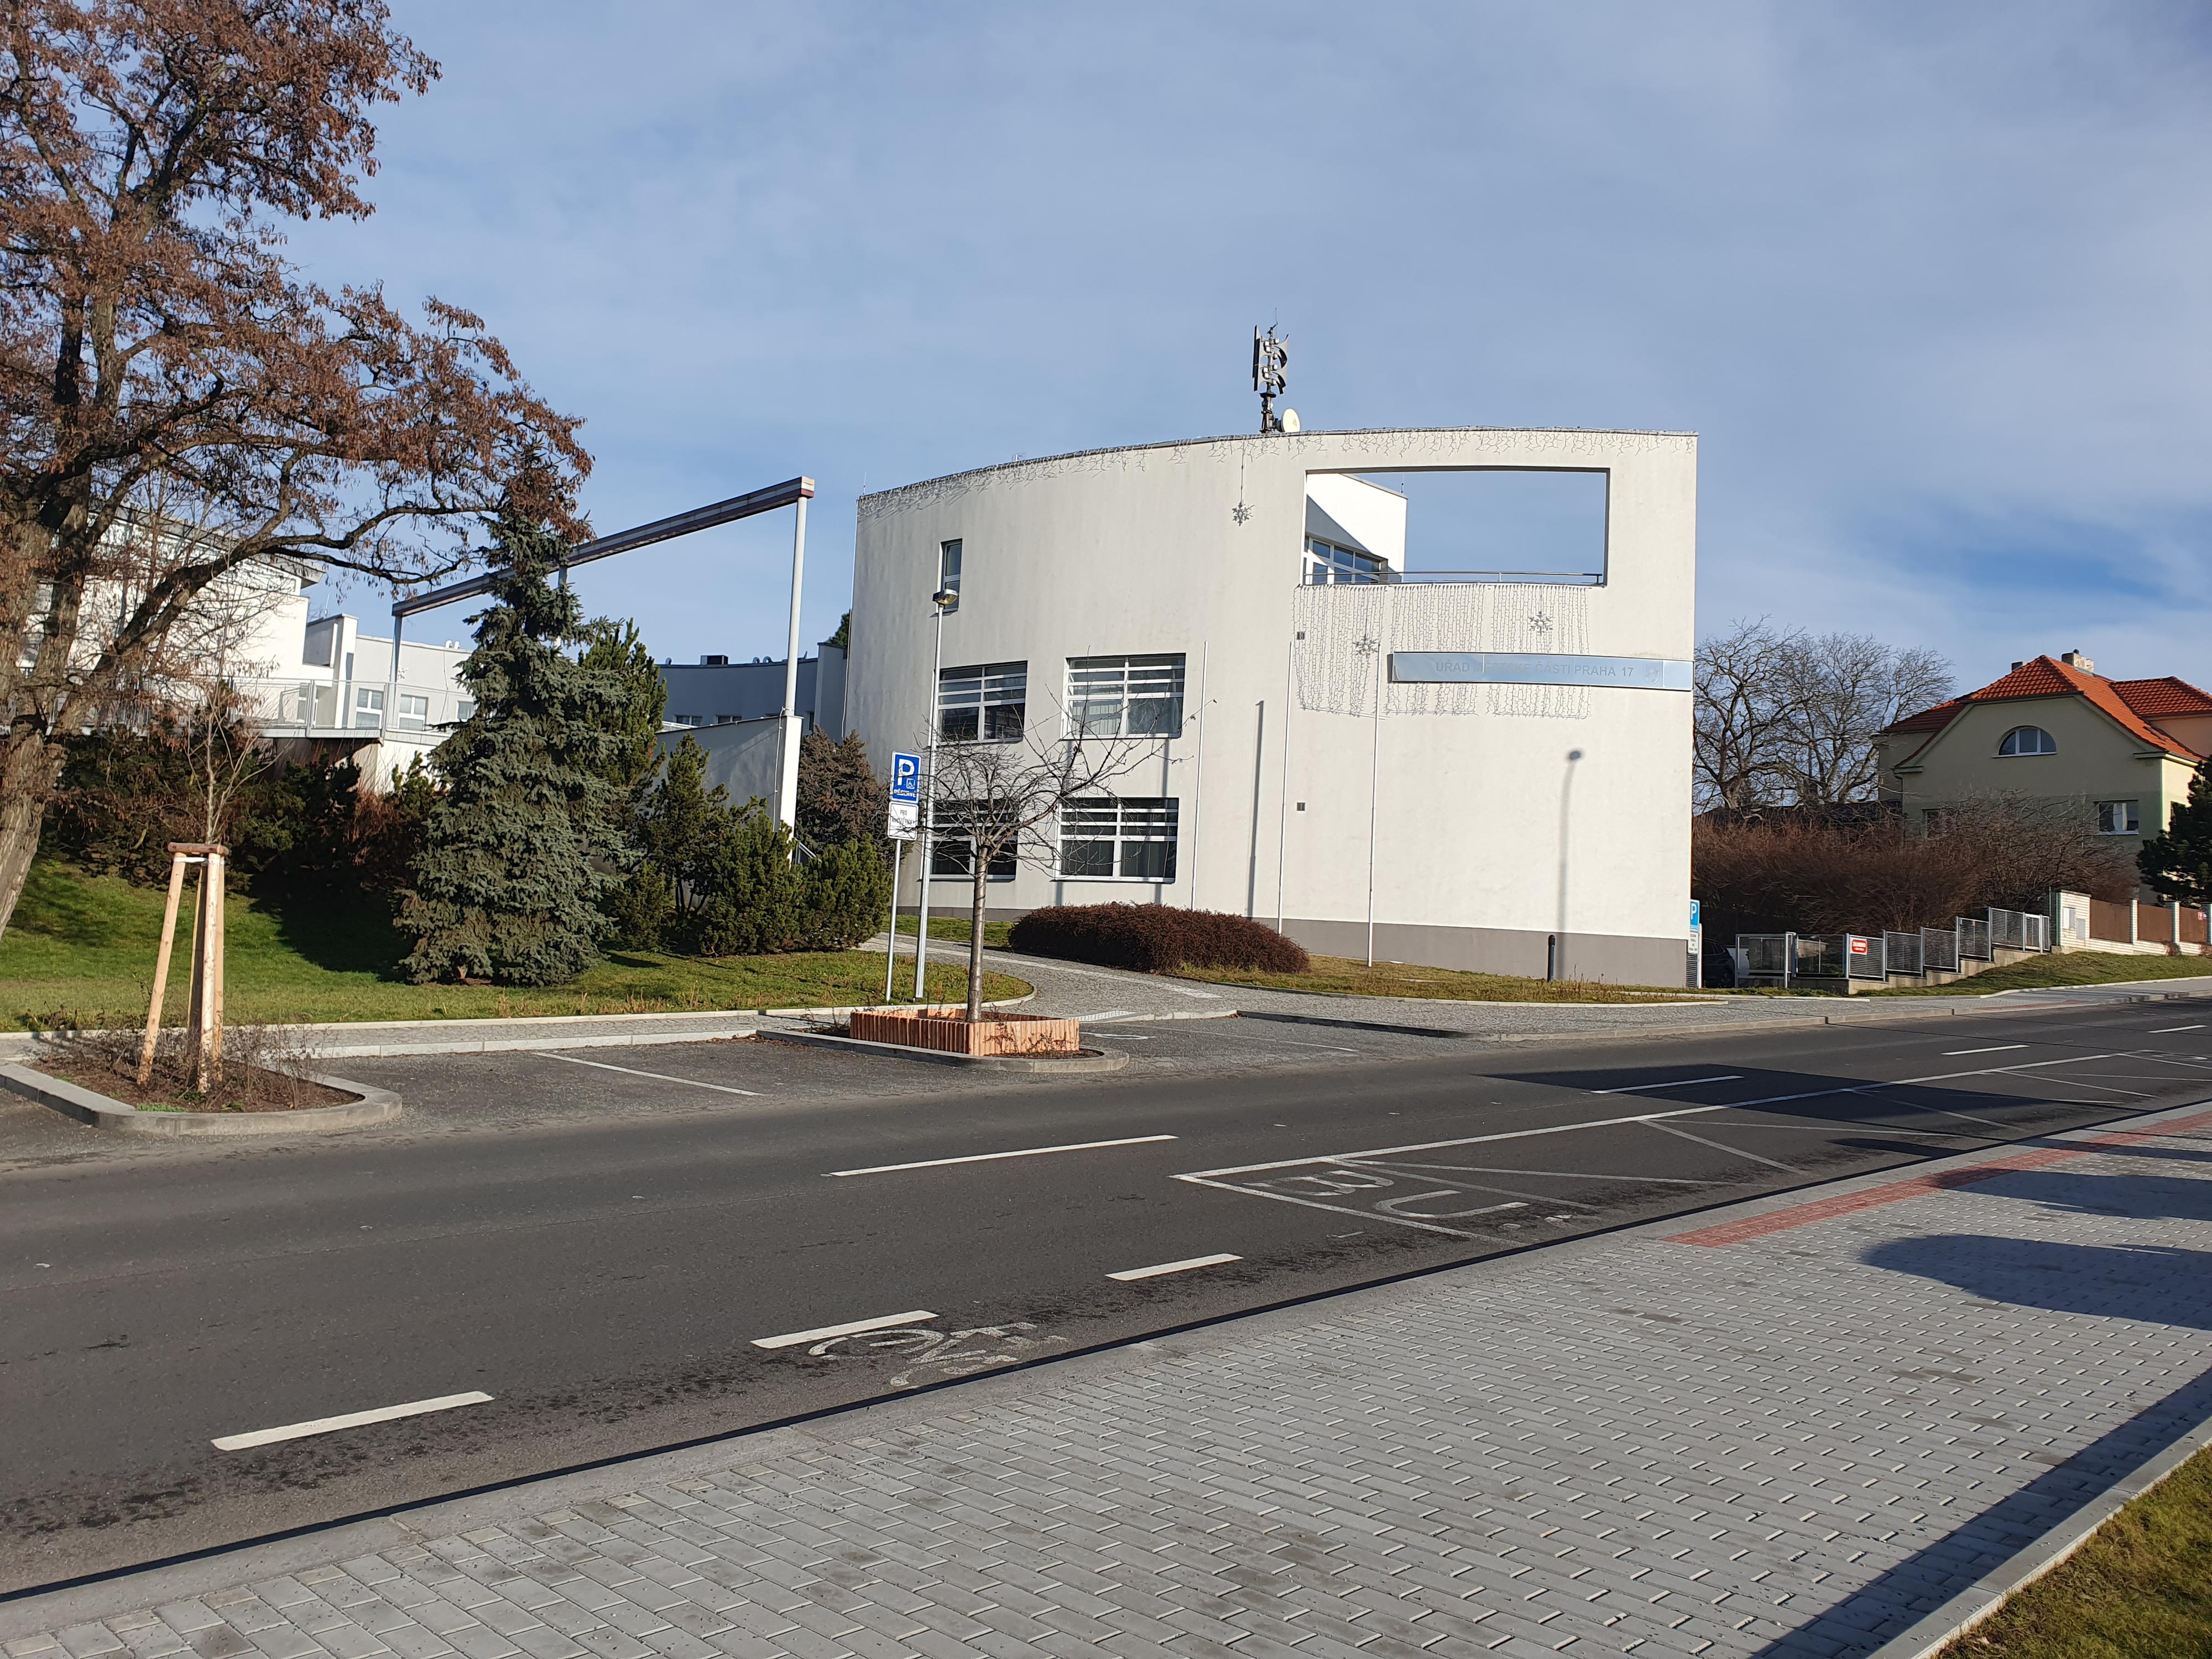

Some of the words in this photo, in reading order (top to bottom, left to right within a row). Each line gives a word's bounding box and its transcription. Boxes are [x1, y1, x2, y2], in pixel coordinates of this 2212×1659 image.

[1436, 659, 1470, 672] ÚŘAD
[1535, 661, 1571, 675] ČÁSTI
[1574, 665, 1616, 676] PRAHA
[1621, 667, 1634, 677] 17
[898, 759, 915, 786] P
[1691, 903, 1697, 920] P
